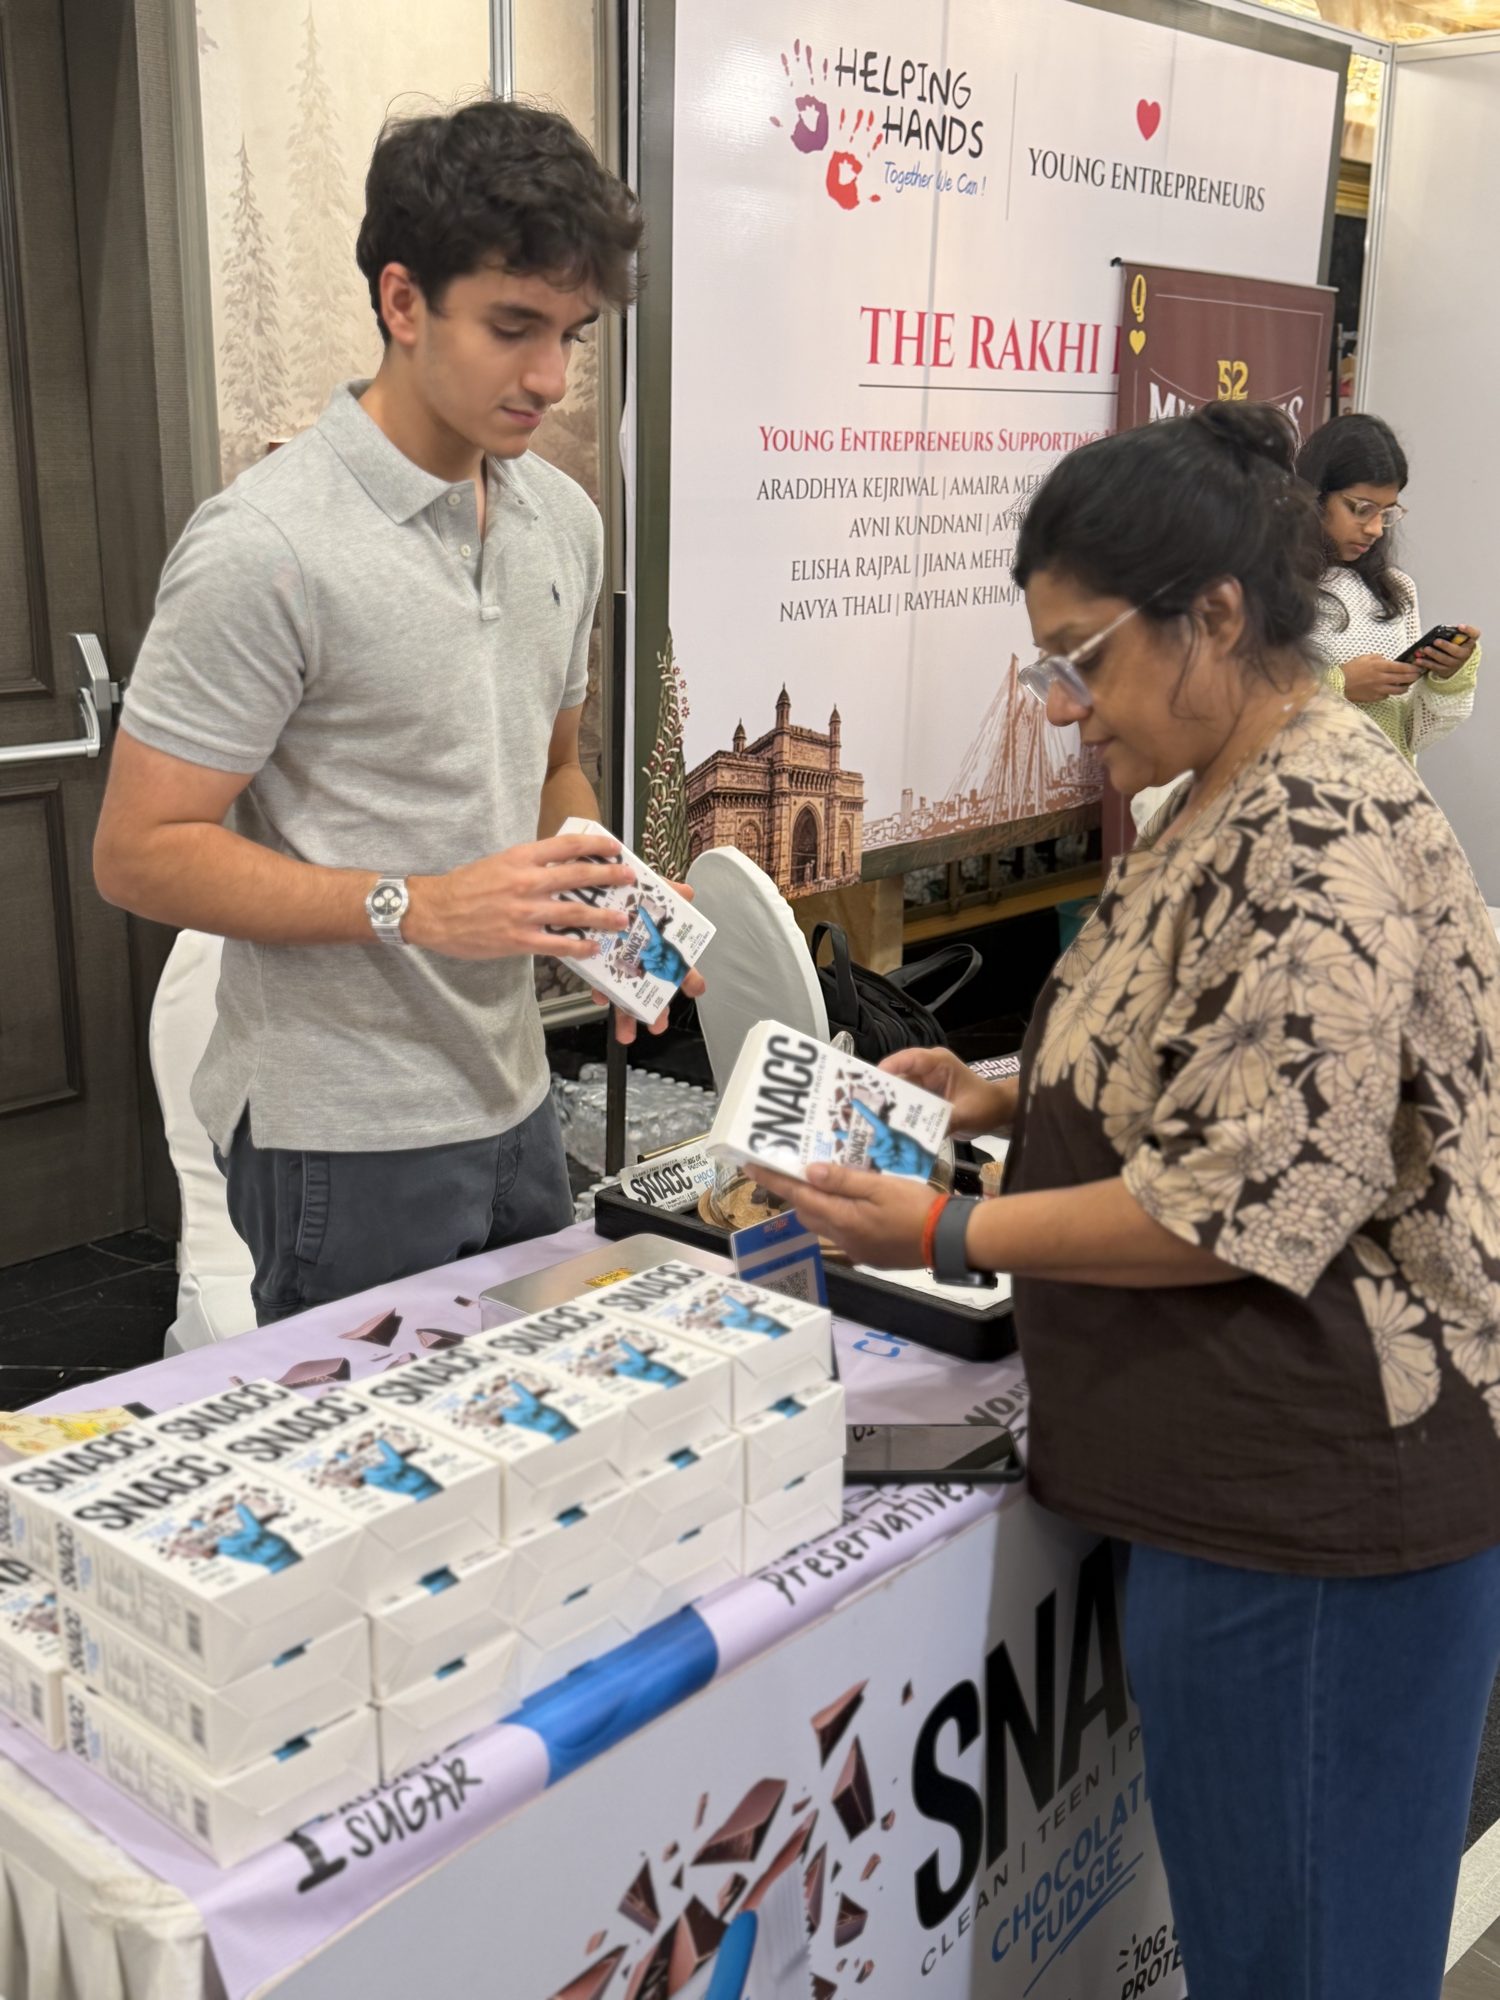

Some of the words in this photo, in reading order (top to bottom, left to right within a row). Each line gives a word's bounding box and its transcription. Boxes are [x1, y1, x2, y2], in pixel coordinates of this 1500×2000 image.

[835, 47, 971, 109] HELPING
[882, 106, 983, 158] HANDS
[885, 161, 933, 191] Together
[935, 169, 953, 193] We
[1028, 147, 1106, 187] YOUNG
[1111, 162, 1266, 212] ENTREPRENEURS
[860, 306, 956, 369] THE
[968, 315, 1103, 374] RAKHI
[1217, 360, 1249, 401] 52
[756, 477, 858, 500] ARADDHYA
[863, 476, 938, 502] KEJRIWAL
[950, 475, 1010, 497] AMAIRA
[849, 517, 890, 538] AVNI
[895, 513, 983, 537] KUNDNANI
[791, 558, 850, 582] ELISHA
[855, 554, 911, 581] RAJPAL
[922, 550, 966, 578] JIANA
[779, 600, 838, 623] NAVYA
[843, 593, 892, 617] THALI
[904, 588, 968, 612] RAYHAN
[747, 1034, 819, 1155] SNACC
[630, 1162, 693, 1206] SNACC
[597, 1263, 706, 1313] SNACC
[486, 1305, 605, 1356] SNACC
[369, 1347, 498, 1405] SNACC
[156, 1383, 290, 1441] SNACC
[225, 1395, 369, 1463] SNACC
[11, 1430, 156, 1494] SNACC
[73, 1453, 232, 1530] SNACC
[345, 1757, 483, 1858] SUGAR
[920, 1869, 1008, 1976] CLEAN
[1037, 1768, 1100, 1845] TEEN
[1030, 1836, 1123, 1963] FUDGE
[1133, 1924, 1168, 1972] 10G
